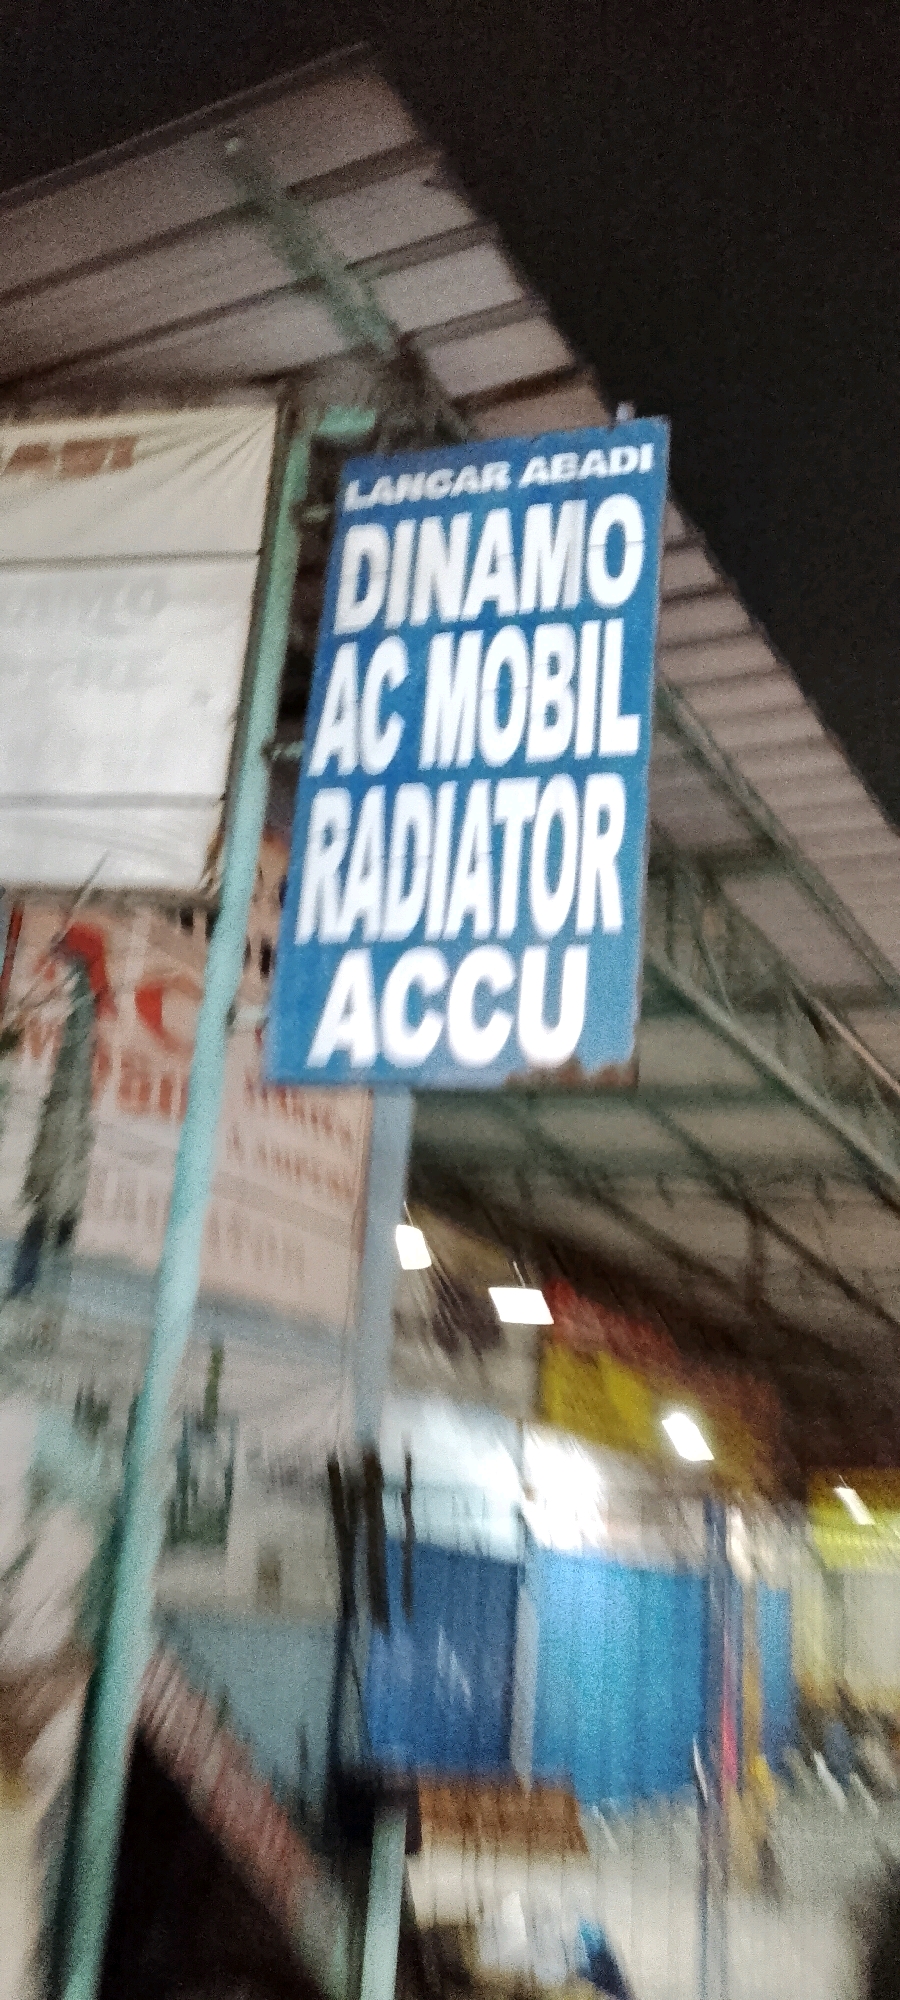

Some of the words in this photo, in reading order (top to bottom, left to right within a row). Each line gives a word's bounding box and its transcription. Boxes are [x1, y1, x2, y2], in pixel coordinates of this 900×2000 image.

[518, 443, 655, 488] ABADI
[334, 493, 645, 635] DINAMO
[307, 635, 410, 777] AC
[418, 617, 641, 771] MOBIL
[295, 773, 626, 945] RADIATOR
[306, 944, 590, 1069] ACCU
